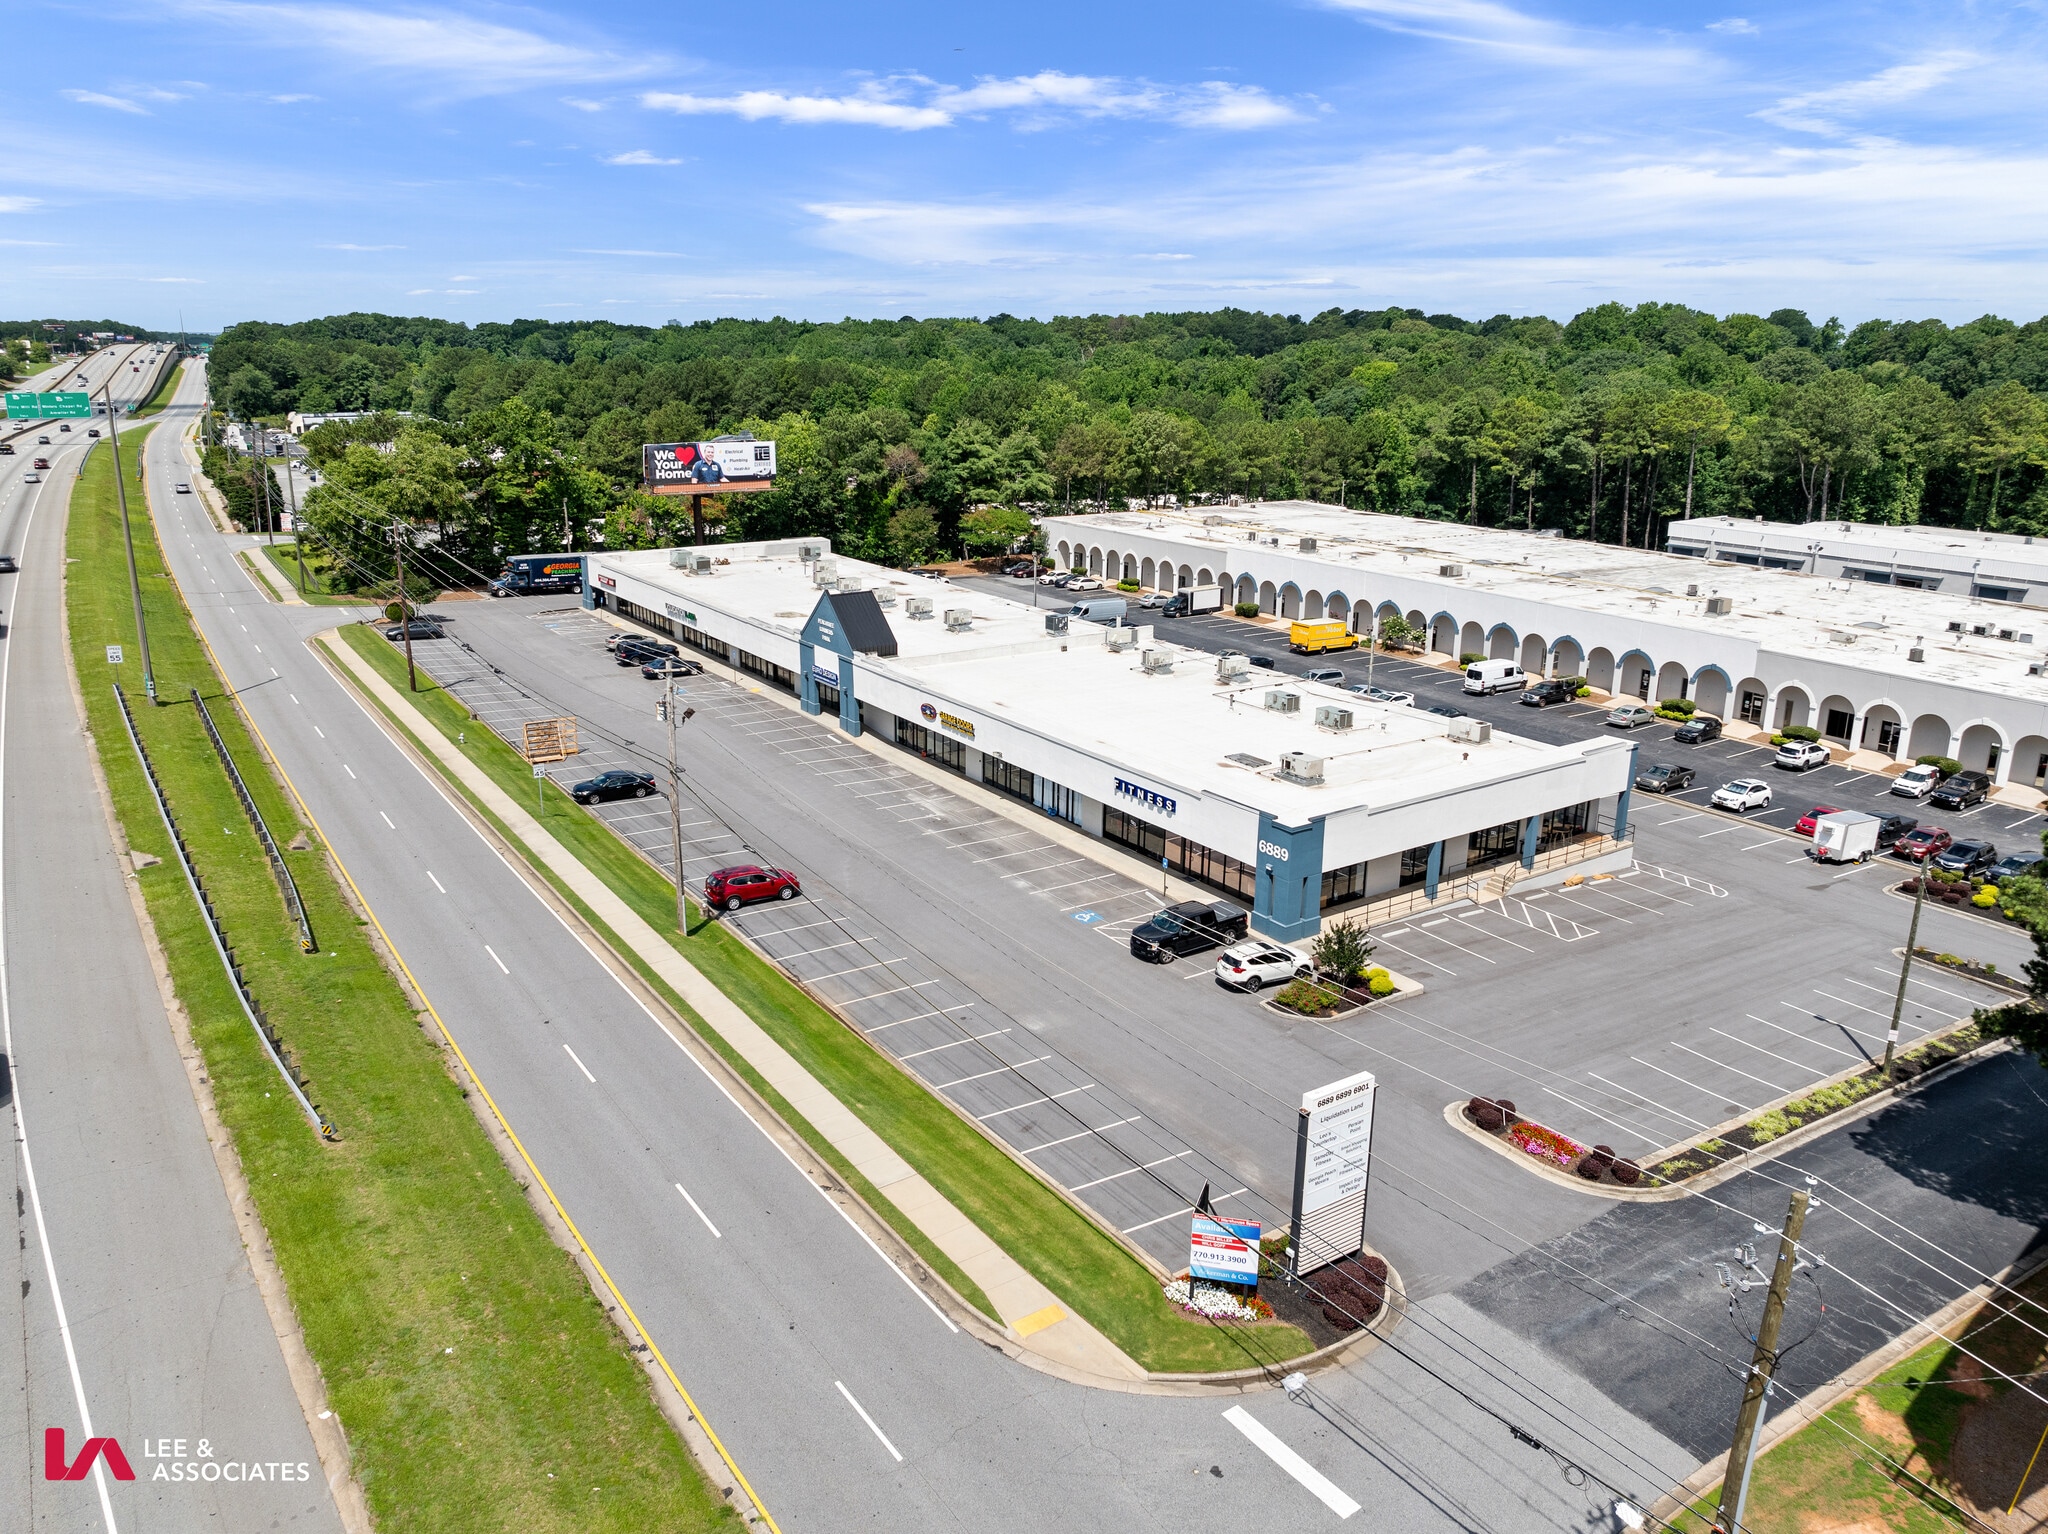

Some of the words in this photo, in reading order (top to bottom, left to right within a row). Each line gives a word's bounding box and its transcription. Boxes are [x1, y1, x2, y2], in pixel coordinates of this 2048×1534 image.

[654, 450, 676, 460] We
[654, 460, 684, 470] Your
[655, 469, 692, 479] Home
[551, 562, 580, 570] GEORGIA
[1115, 780, 1174, 811] FITNESS
[1259, 840, 1289, 862] 6889
[1317, 1095, 1334, 1107] 6889
[1335, 1089, 1352, 1101] 6899
[1353, 1083, 1370, 1094] 6901
[1320, 1108, 1350, 1123] Liquidation
[1350, 1102, 1364, 1112] Land
[1348, 1119, 1364, 1128] Persian
[1350, 1126, 1361, 1134] Point
[1312, 1135, 1337, 1148] Countertop
[1313, 1150, 1334, 1161] GameDay
[1315, 1158, 1331, 1167] Fitness
[1339, 1167, 1353, 1176] Fitness
[1308, 1174, 1324, 1184] Georgia
[1314, 1177, 1329, 1186] Movers
[1339, 1180, 1353, 1189] Impact
[1353, 1176, 1364, 1184] Sign
[1345, 1183, 1360, 1193] Design
[1193, 1250, 1247, 1264] 770.913.3900
[1198, 1268, 1230, 1278] Akerman
[1237, 1273, 1249, 1281] Co.
